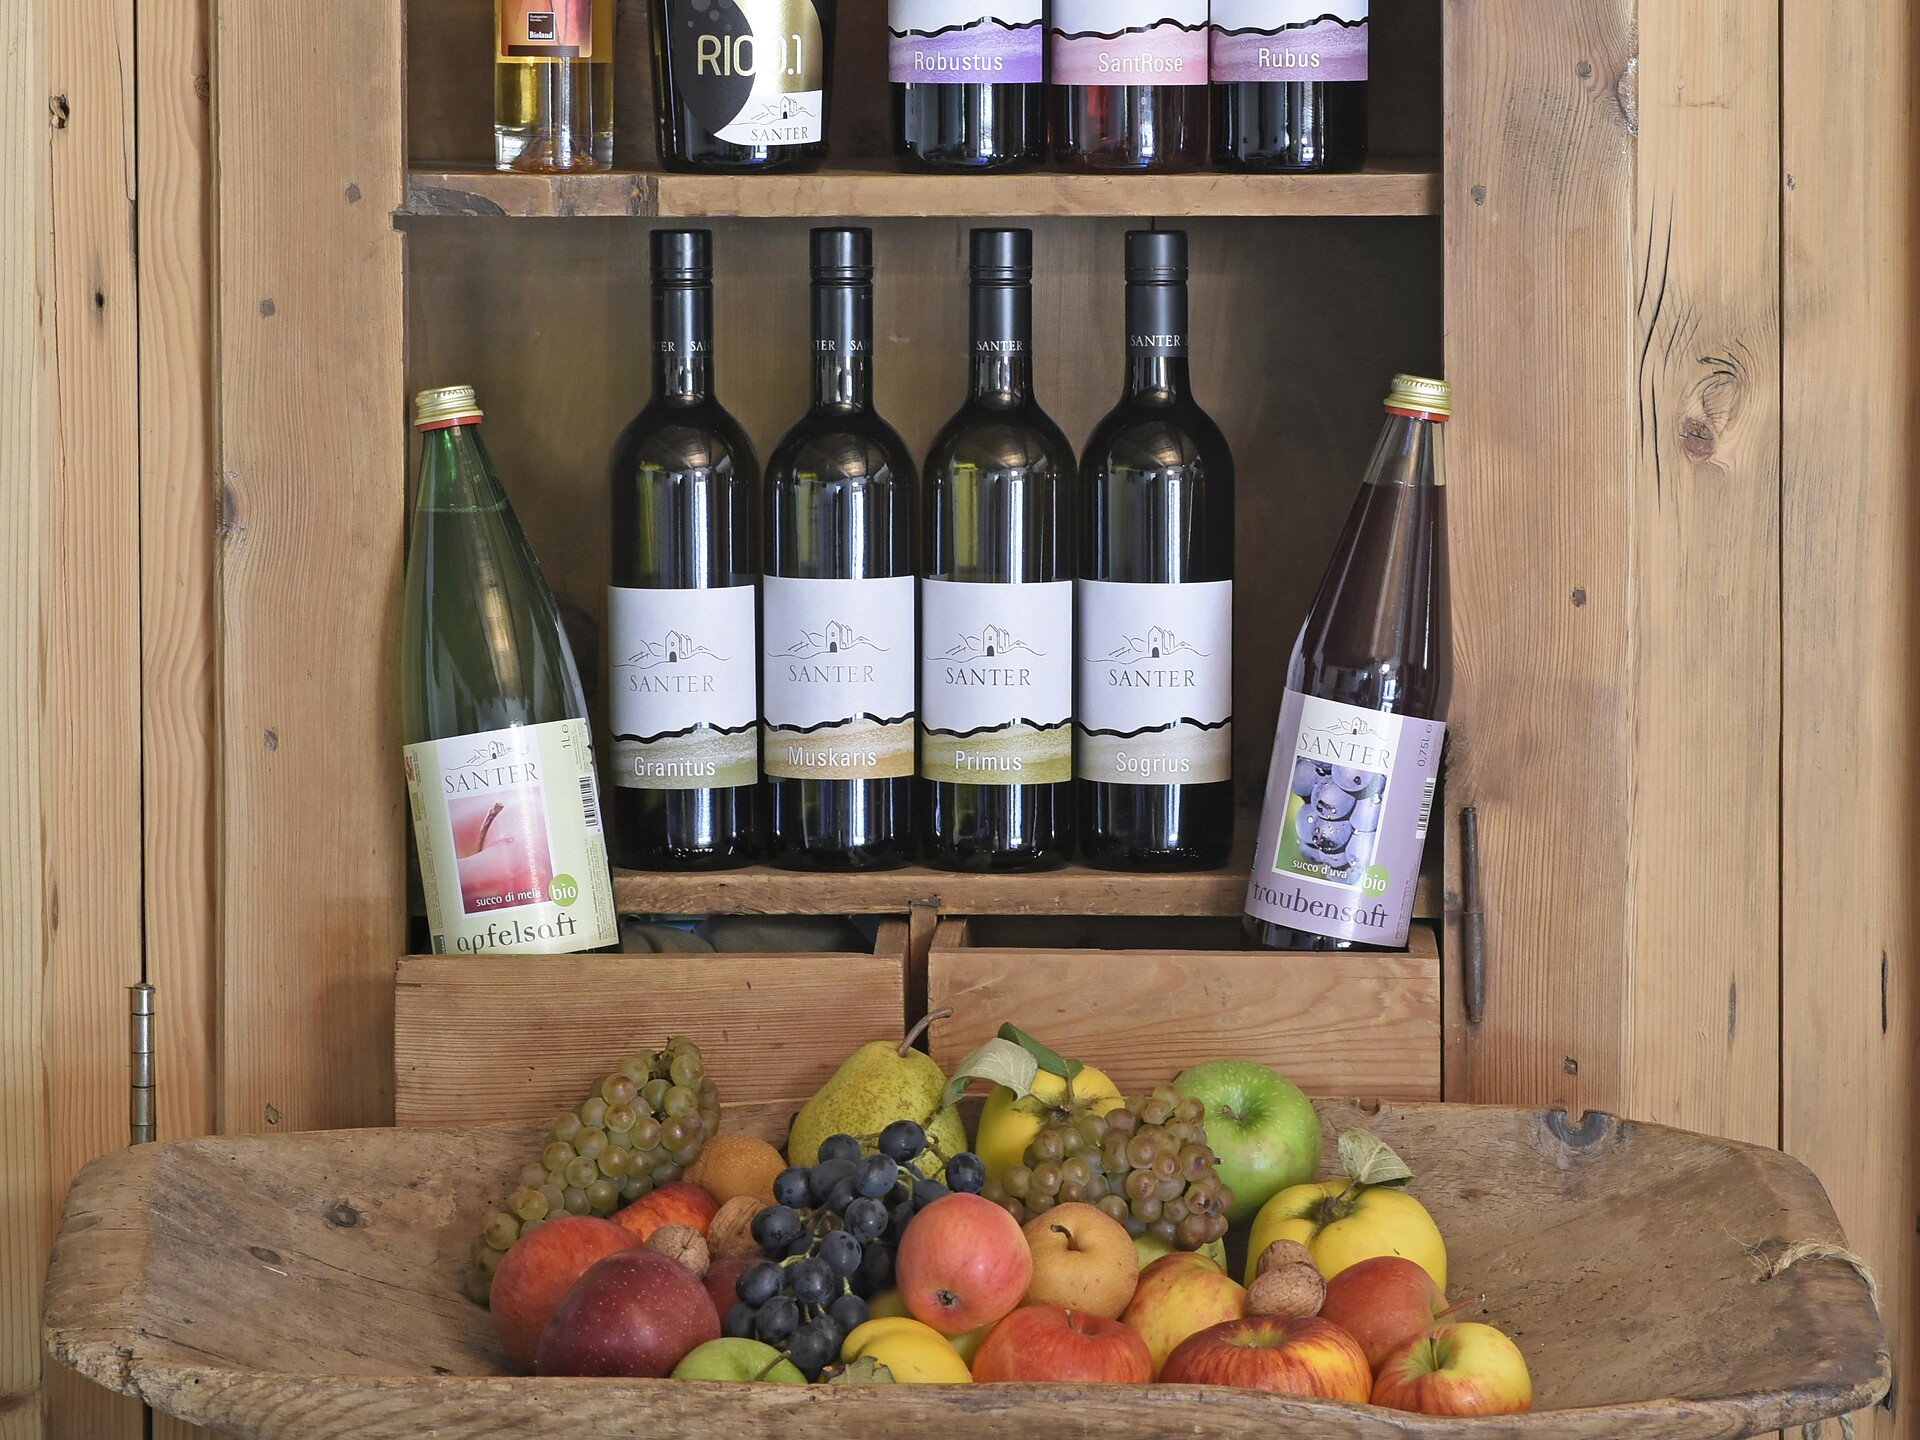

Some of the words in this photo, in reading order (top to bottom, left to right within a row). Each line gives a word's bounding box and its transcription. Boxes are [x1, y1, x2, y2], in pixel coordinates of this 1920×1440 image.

[913, 50, 1004, 72] Robustus
[1098, 51, 1184, 73] SantRosé
[1258, 47, 1321, 69] Rubus
[750, 126, 809, 142] SANTER
[976, 340, 1024, 352] SANTER
[1130, 334, 1182, 347] SANTER
[629, 674, 715, 693] SANTER
[788, 664, 876, 684] SANTER
[945, 666, 1033, 687] SANTER
[1108, 668, 1197, 688] SANTER
[788, 746, 878, 767] Muskaris
[955, 750, 1023, 772] Primus
[1298, 732, 1392, 769] SANTER
[634, 756, 717, 777] Granitus
[1115, 752, 1190, 777] Sogrius
[444, 762, 539, 794] SANTER
[1292, 859, 1319, 873] succo
[1320, 864, 1348, 880] d'uva
[1363, 870, 1386, 892] bio
[476, 895, 503, 907] succo
[504, 891, 515, 903] di
[517, 888, 542, 901] mela
[551, 883, 577, 901] bio
[1253, 880, 1389, 928] traubensaft
[456, 911, 578, 954] apfelsaft
